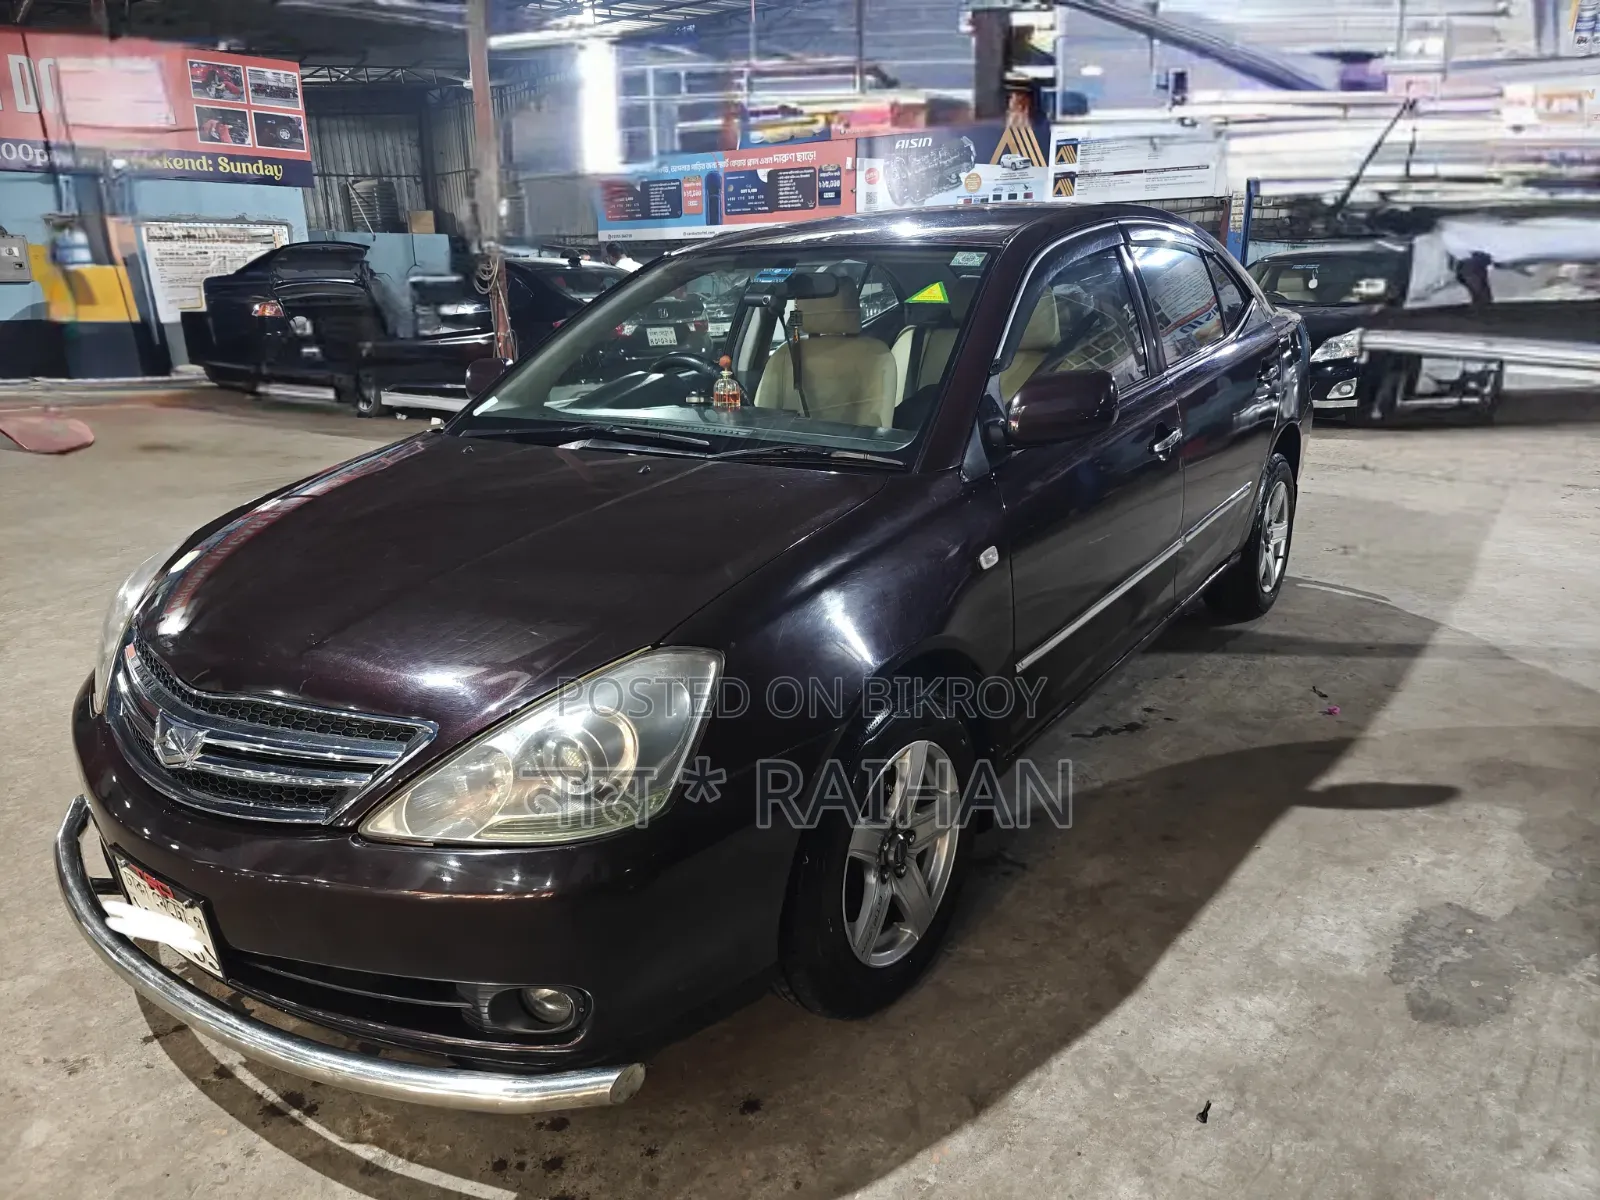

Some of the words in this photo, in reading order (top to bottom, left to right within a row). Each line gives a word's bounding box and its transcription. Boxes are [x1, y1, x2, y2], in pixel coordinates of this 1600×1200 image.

[895, 137, 932, 149] AISIN
[773, 153, 795, 163] দারুণ
[217, 156, 283, 181] Sunday
